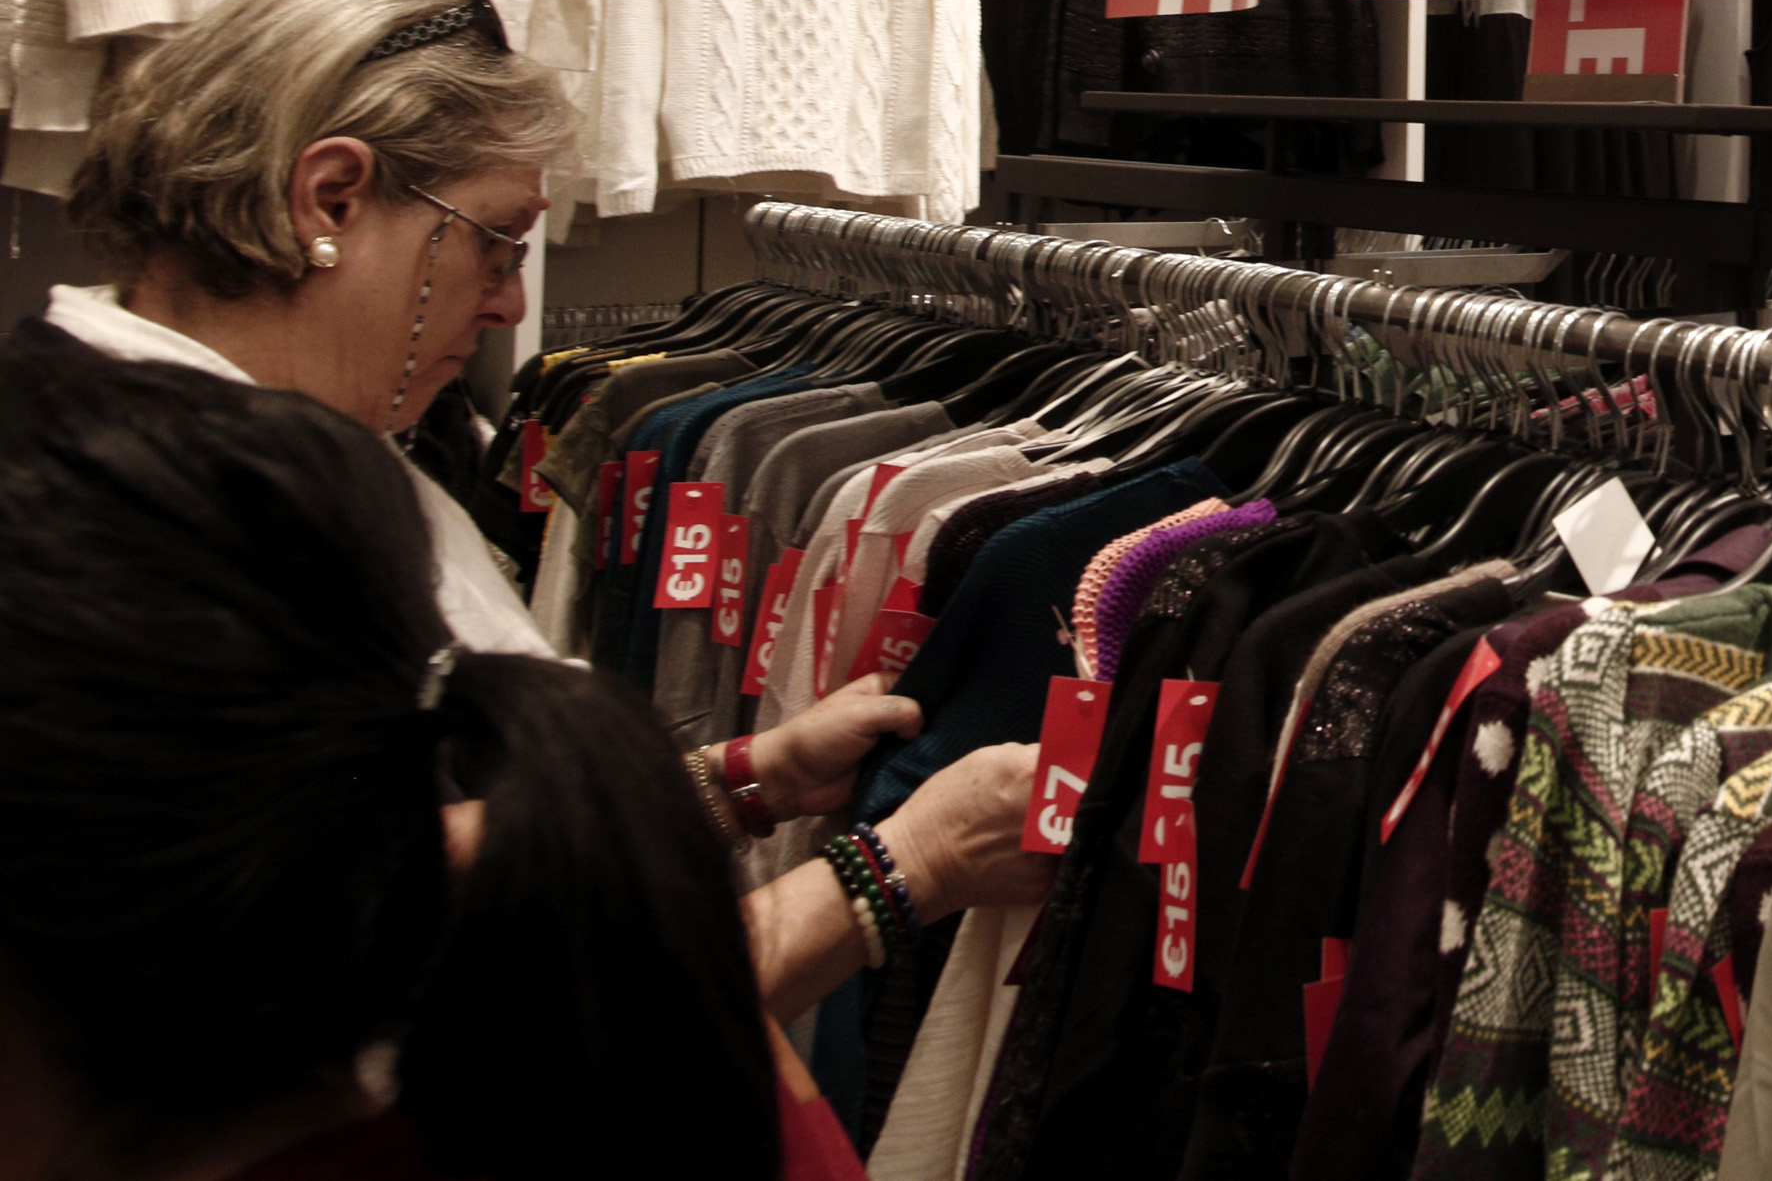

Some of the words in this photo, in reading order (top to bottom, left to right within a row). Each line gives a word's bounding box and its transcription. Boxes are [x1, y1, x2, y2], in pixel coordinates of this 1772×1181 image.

[666, 524, 712, 601] €15
[718, 558, 743, 637] €15
[878, 636, 920, 671] 15
[1038, 765, 1088, 846] €7
[1154, 742, 1203, 846] 15
[1162, 862, 1191, 978] €15
